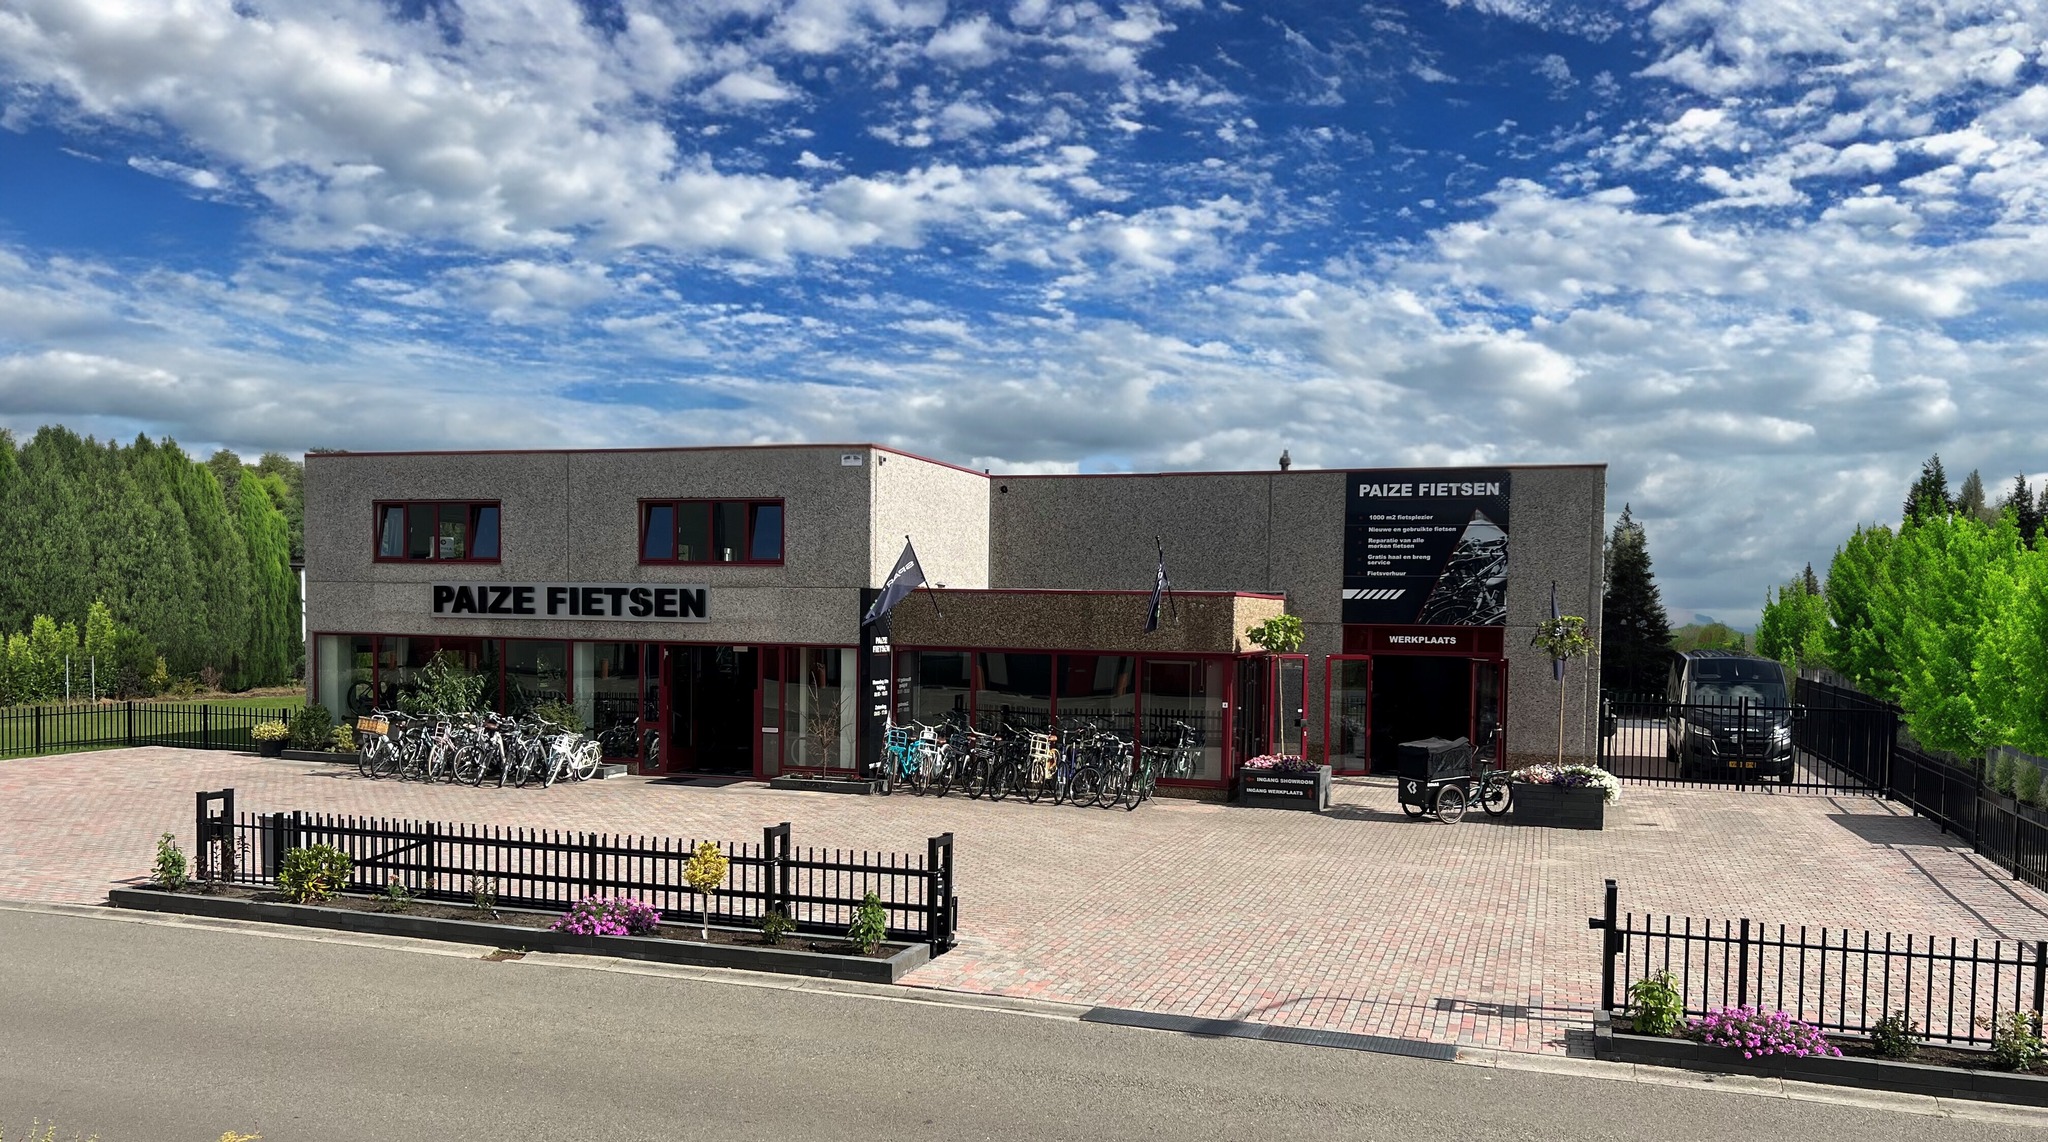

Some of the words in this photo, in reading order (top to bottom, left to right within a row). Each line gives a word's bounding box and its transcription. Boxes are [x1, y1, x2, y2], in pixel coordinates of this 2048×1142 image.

[1359, 483, 1413, 497] PAIZE
[1418, 482, 1500, 496] FIETSEN
[433, 585, 536, 615] PAIZE
[546, 586, 707, 618] FIETSEN
[1389, 635, 1457, 645] WERKPLAATS
